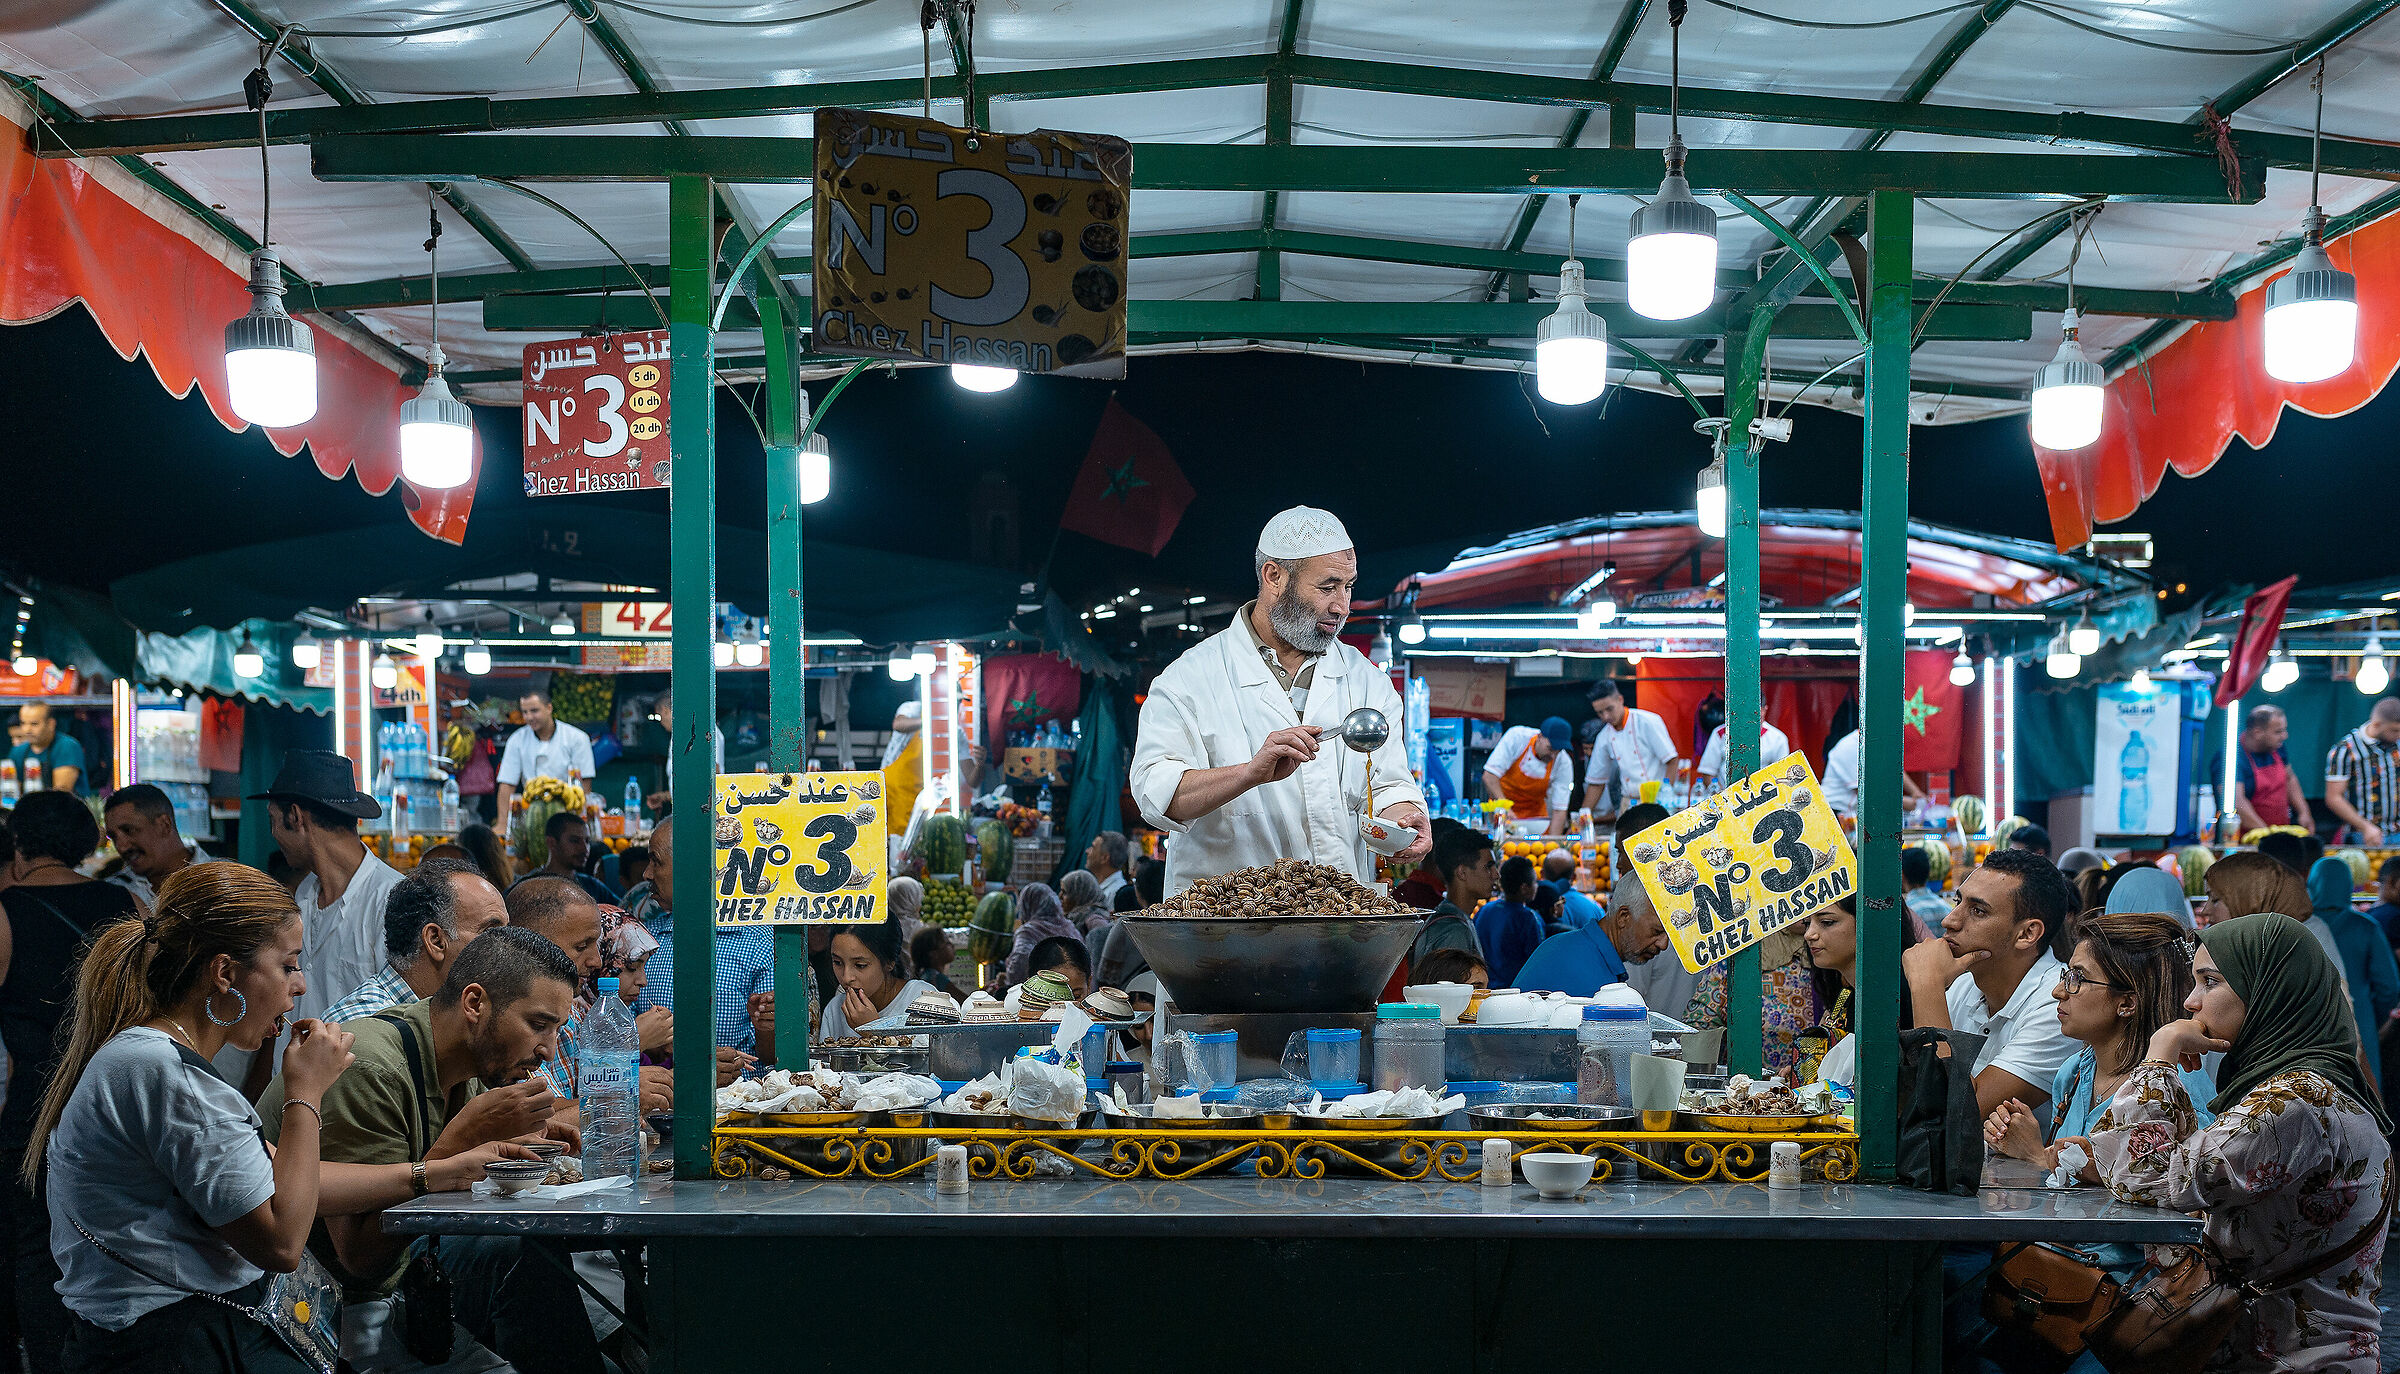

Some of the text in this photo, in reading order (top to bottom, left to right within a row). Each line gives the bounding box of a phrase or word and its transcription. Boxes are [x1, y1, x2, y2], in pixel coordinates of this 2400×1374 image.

[929, 168, 1031, 327] 3
[819, 310, 1053, 371] Chez Hassan
[530, 344, 599, 382] حسن
[634, 371, 656, 382] 5 dh
[583, 373, 629, 458] 3
[633, 396, 660, 407] 10 dh
[632, 423, 661, 434] 20 dh
[575, 467, 641, 492] Hassan
[725, 776, 849, 814] عند حسن
[795, 814, 858, 894] 3
[1752, 808, 1815, 894] 3
[716, 895, 875, 922] HEZ HASSAN
[1693, 867, 1851, 967] CHEZ HASSAN
